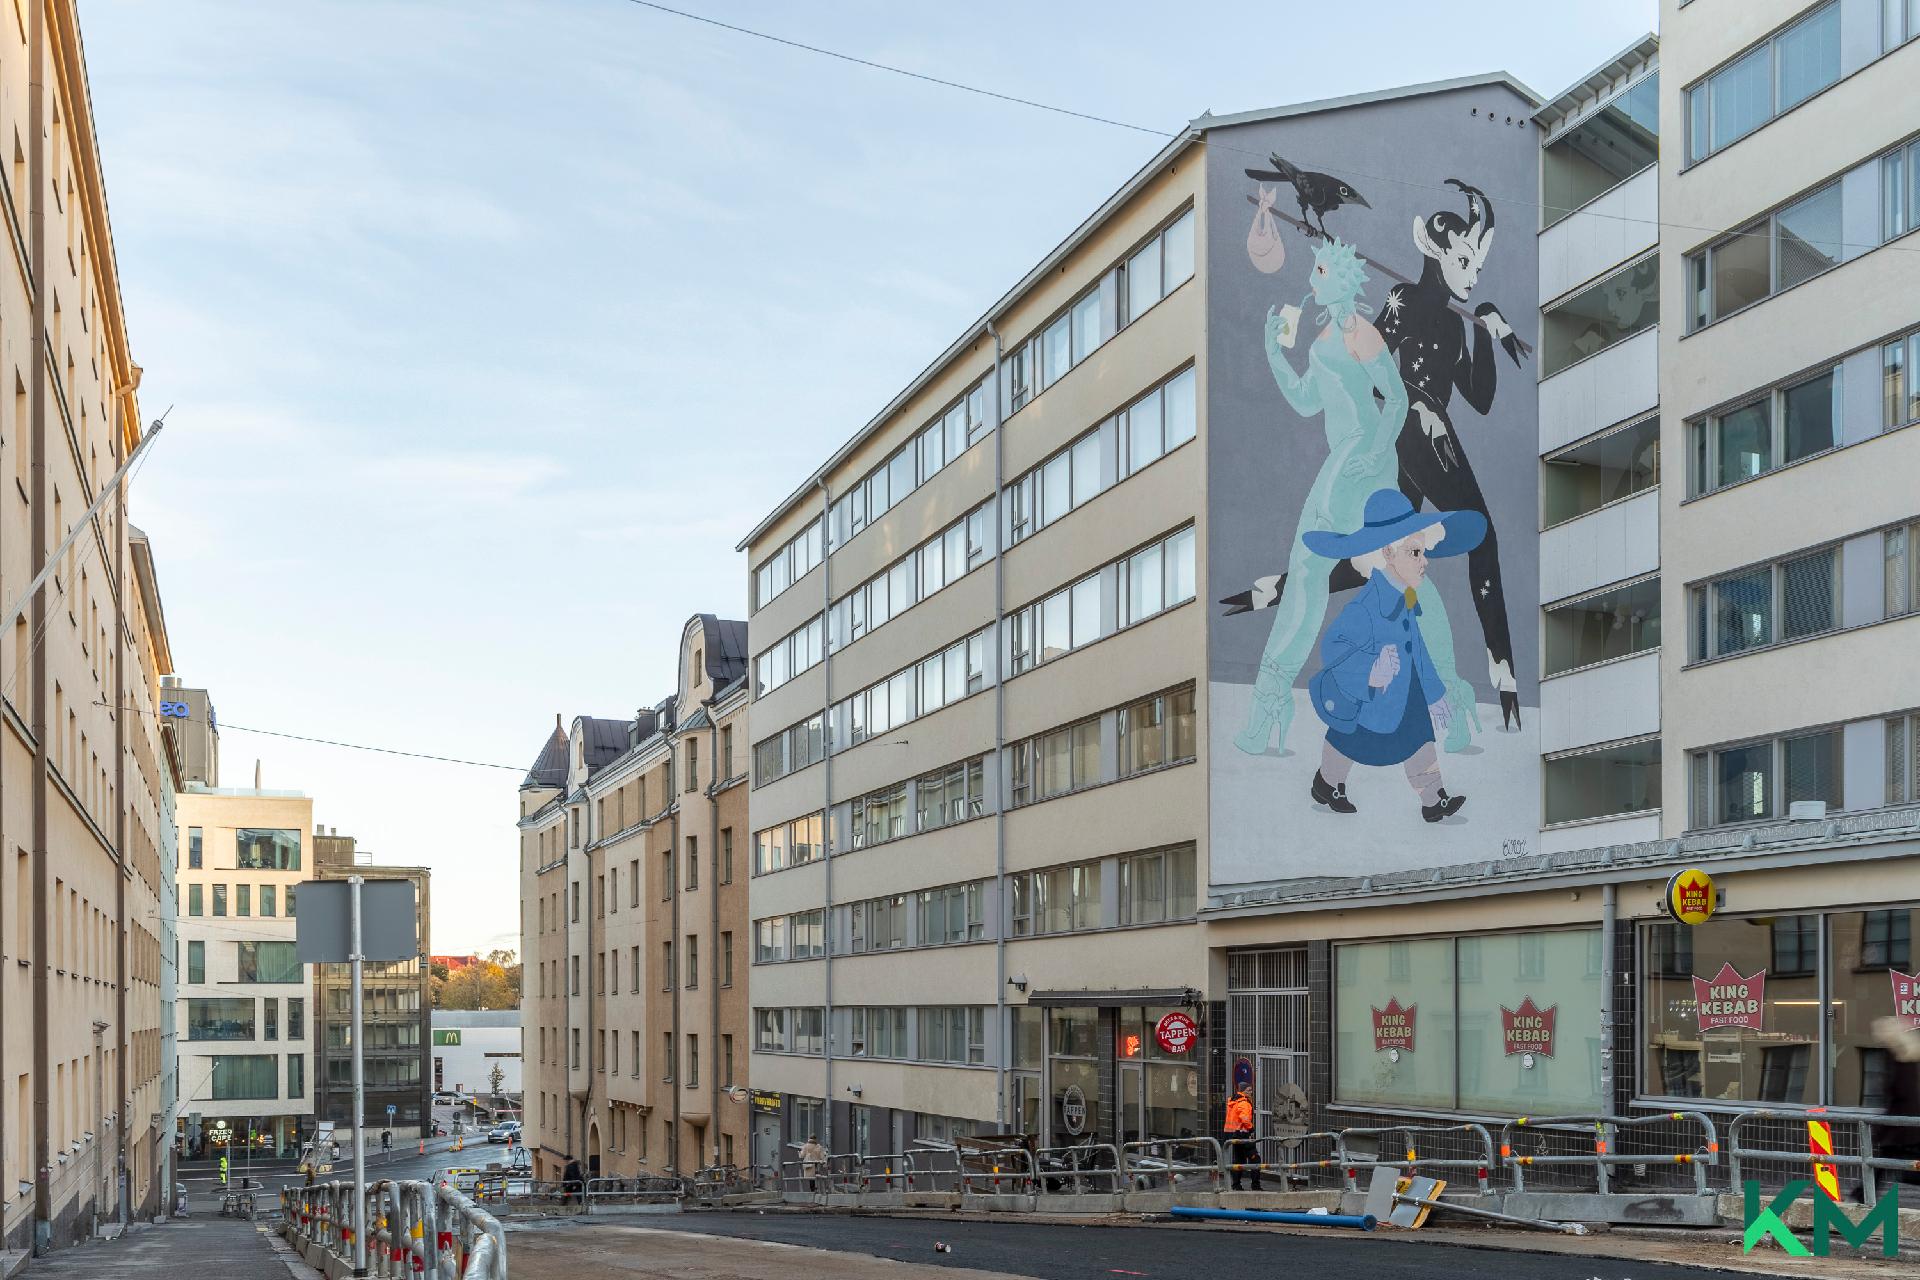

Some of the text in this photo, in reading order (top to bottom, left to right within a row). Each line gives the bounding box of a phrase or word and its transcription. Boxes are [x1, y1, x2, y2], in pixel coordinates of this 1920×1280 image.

[1686, 890, 1703, 898] KING
[1682, 898, 1707, 906] KEBAB
[1710, 985, 1749, 999] KING
[1701, 1000, 1759, 1015] KEBAB
[1381, 1014, 1406, 1026] KING
[1513, 1016, 1543, 1028] KING
[1728, 1016, 1749, 1024] FOOD
[1160, 1028, 1196, 1040] TAPPEN
[1376, 1026, 1412, 1038] KEBAB
[1506, 1029, 1550, 1041] KEBAB
[1171, 1044, 1186, 1053] BAR
